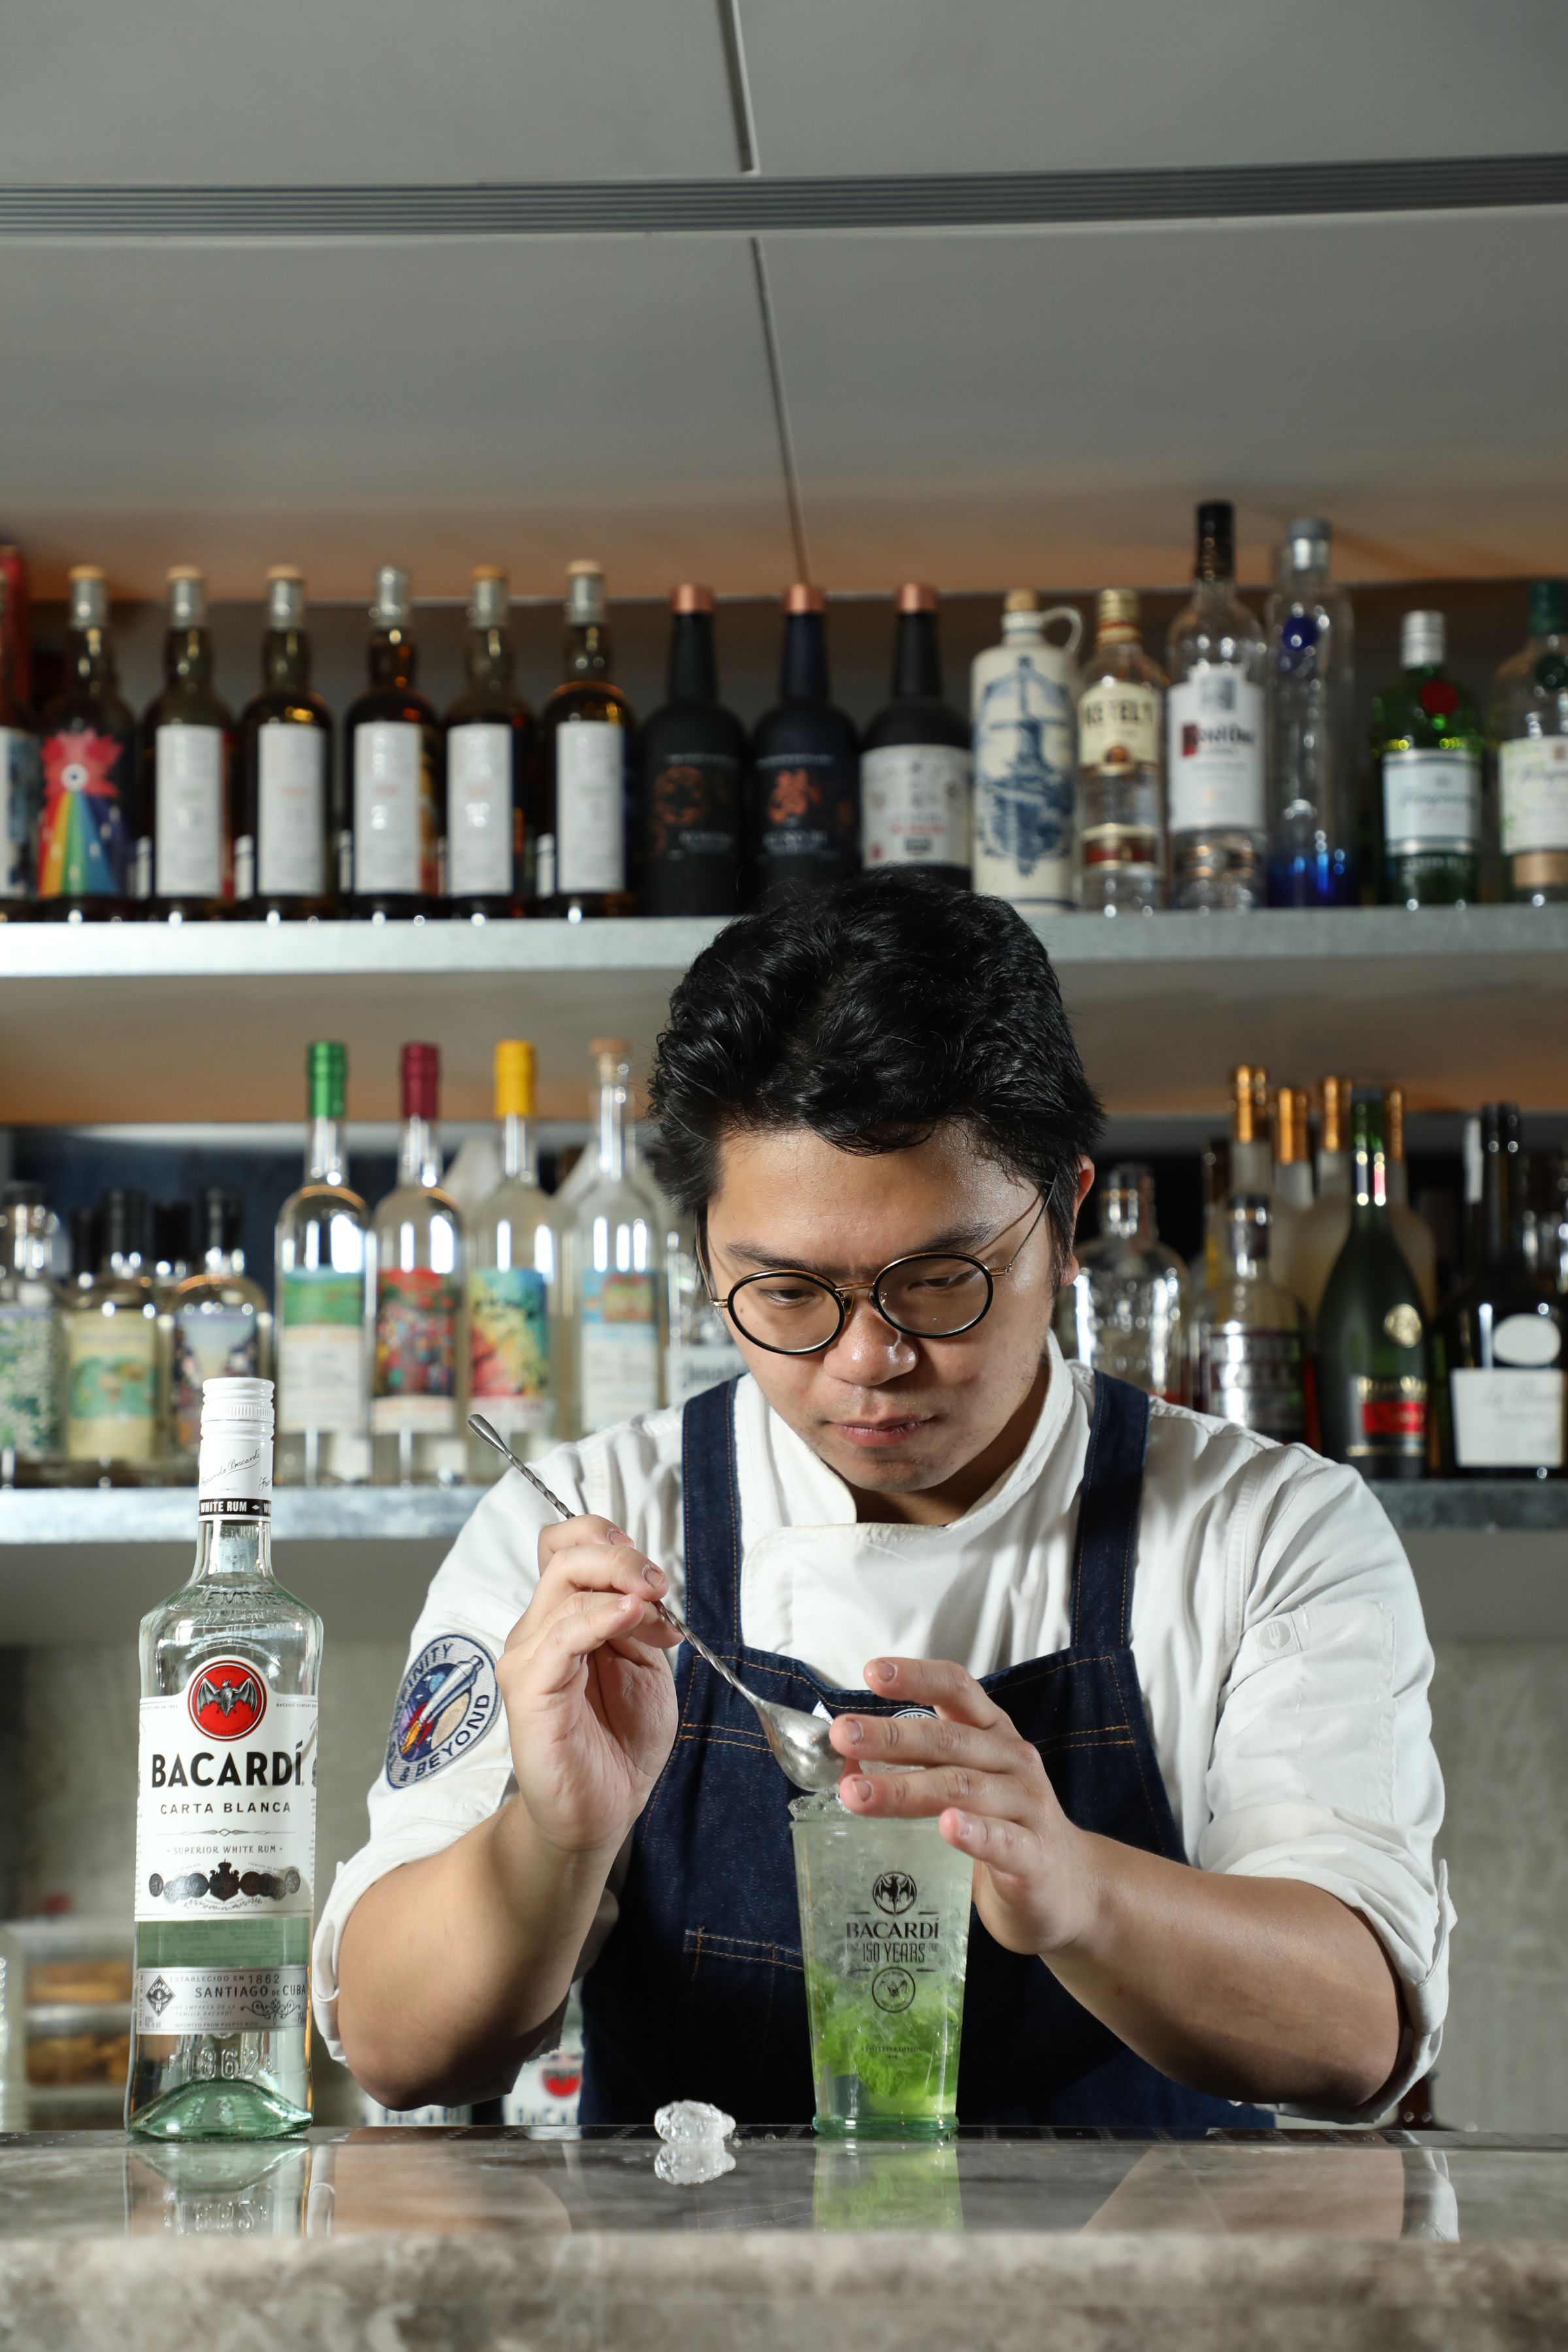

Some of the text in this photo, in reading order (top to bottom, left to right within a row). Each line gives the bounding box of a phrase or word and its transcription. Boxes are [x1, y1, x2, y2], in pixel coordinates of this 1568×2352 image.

[201, 1501, 223, 1512] WHITE
[226, 1501, 248, 1512] RUM
[414, 1694, 490, 1778] BEYOND
[151, 1740, 303, 1788] BACARDÍ
[160, 1801, 291, 1814] CARTA BLANCA
[174, 1846, 220, 1855] SUPERIOR
[846, 1918, 939, 1940] BACARDÍ
[862, 1943, 880, 1963] 150
[884, 1943, 926, 1963] YEARS
[249, 1974, 280, 1985] 1862
[195, 1985, 269, 1999] SANTIAGO
[282, 1985, 306, 1996] CUBA
